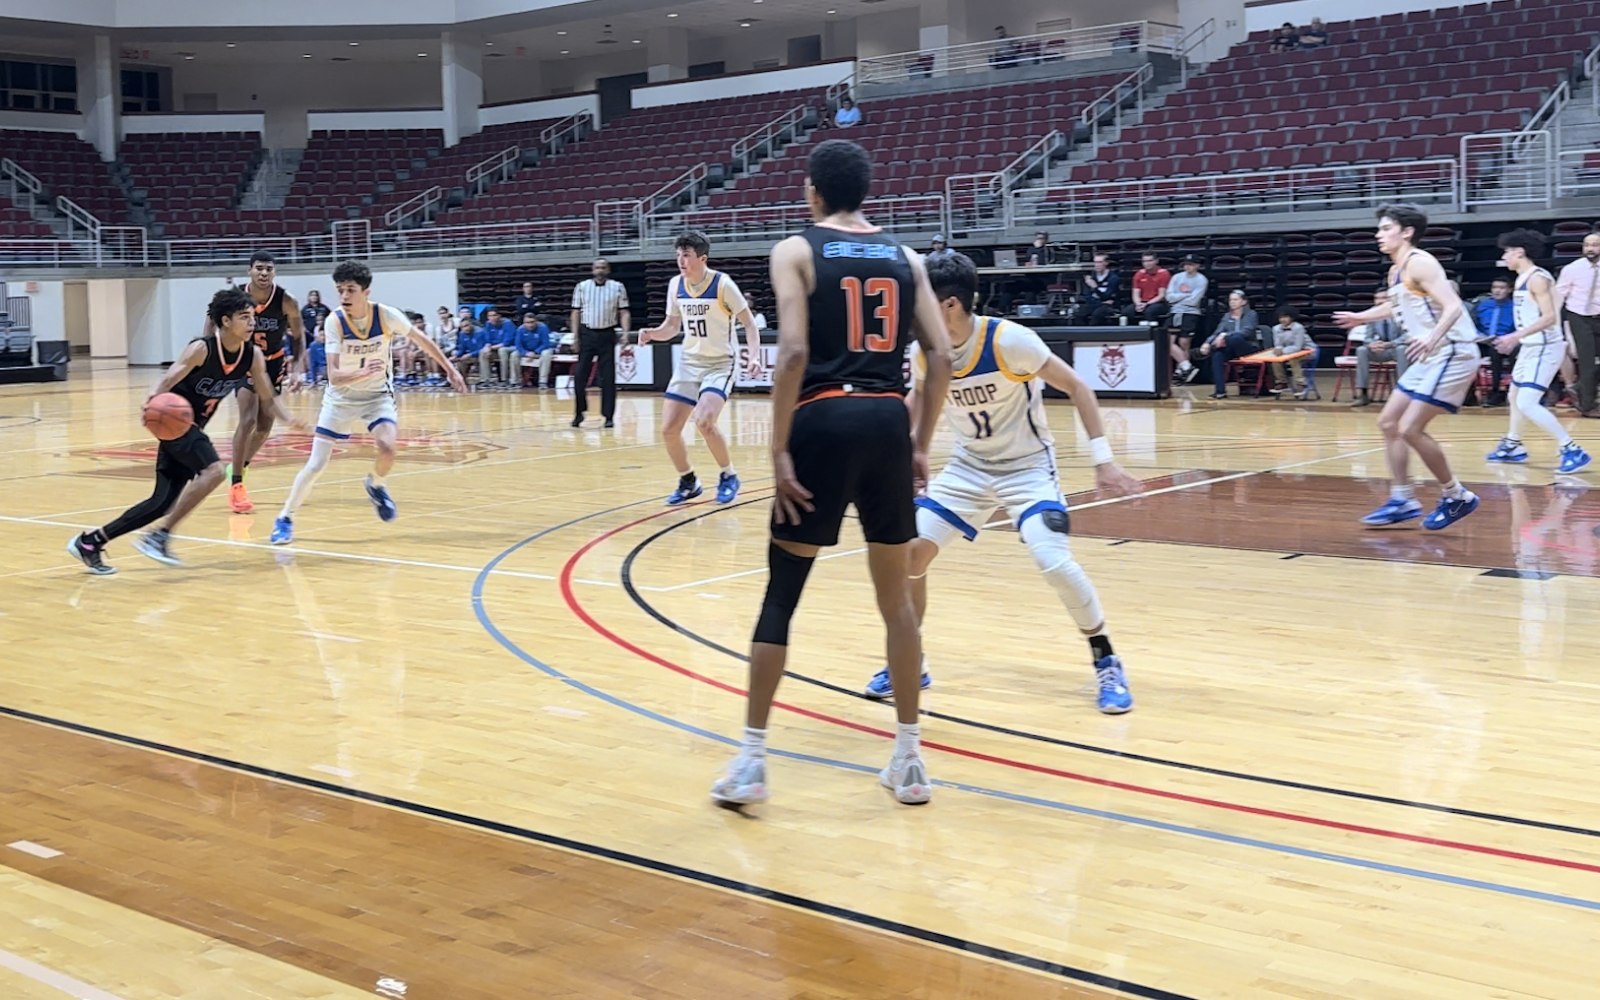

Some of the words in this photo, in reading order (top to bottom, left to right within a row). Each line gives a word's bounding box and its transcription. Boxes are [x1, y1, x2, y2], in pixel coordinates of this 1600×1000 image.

[682, 304, 710, 316] TROOP
[840, 276, 899, 352] 13
[688, 319, 707, 337] 50
[346, 341, 382, 355] TROOP
[968, 410, 992, 439] 11
